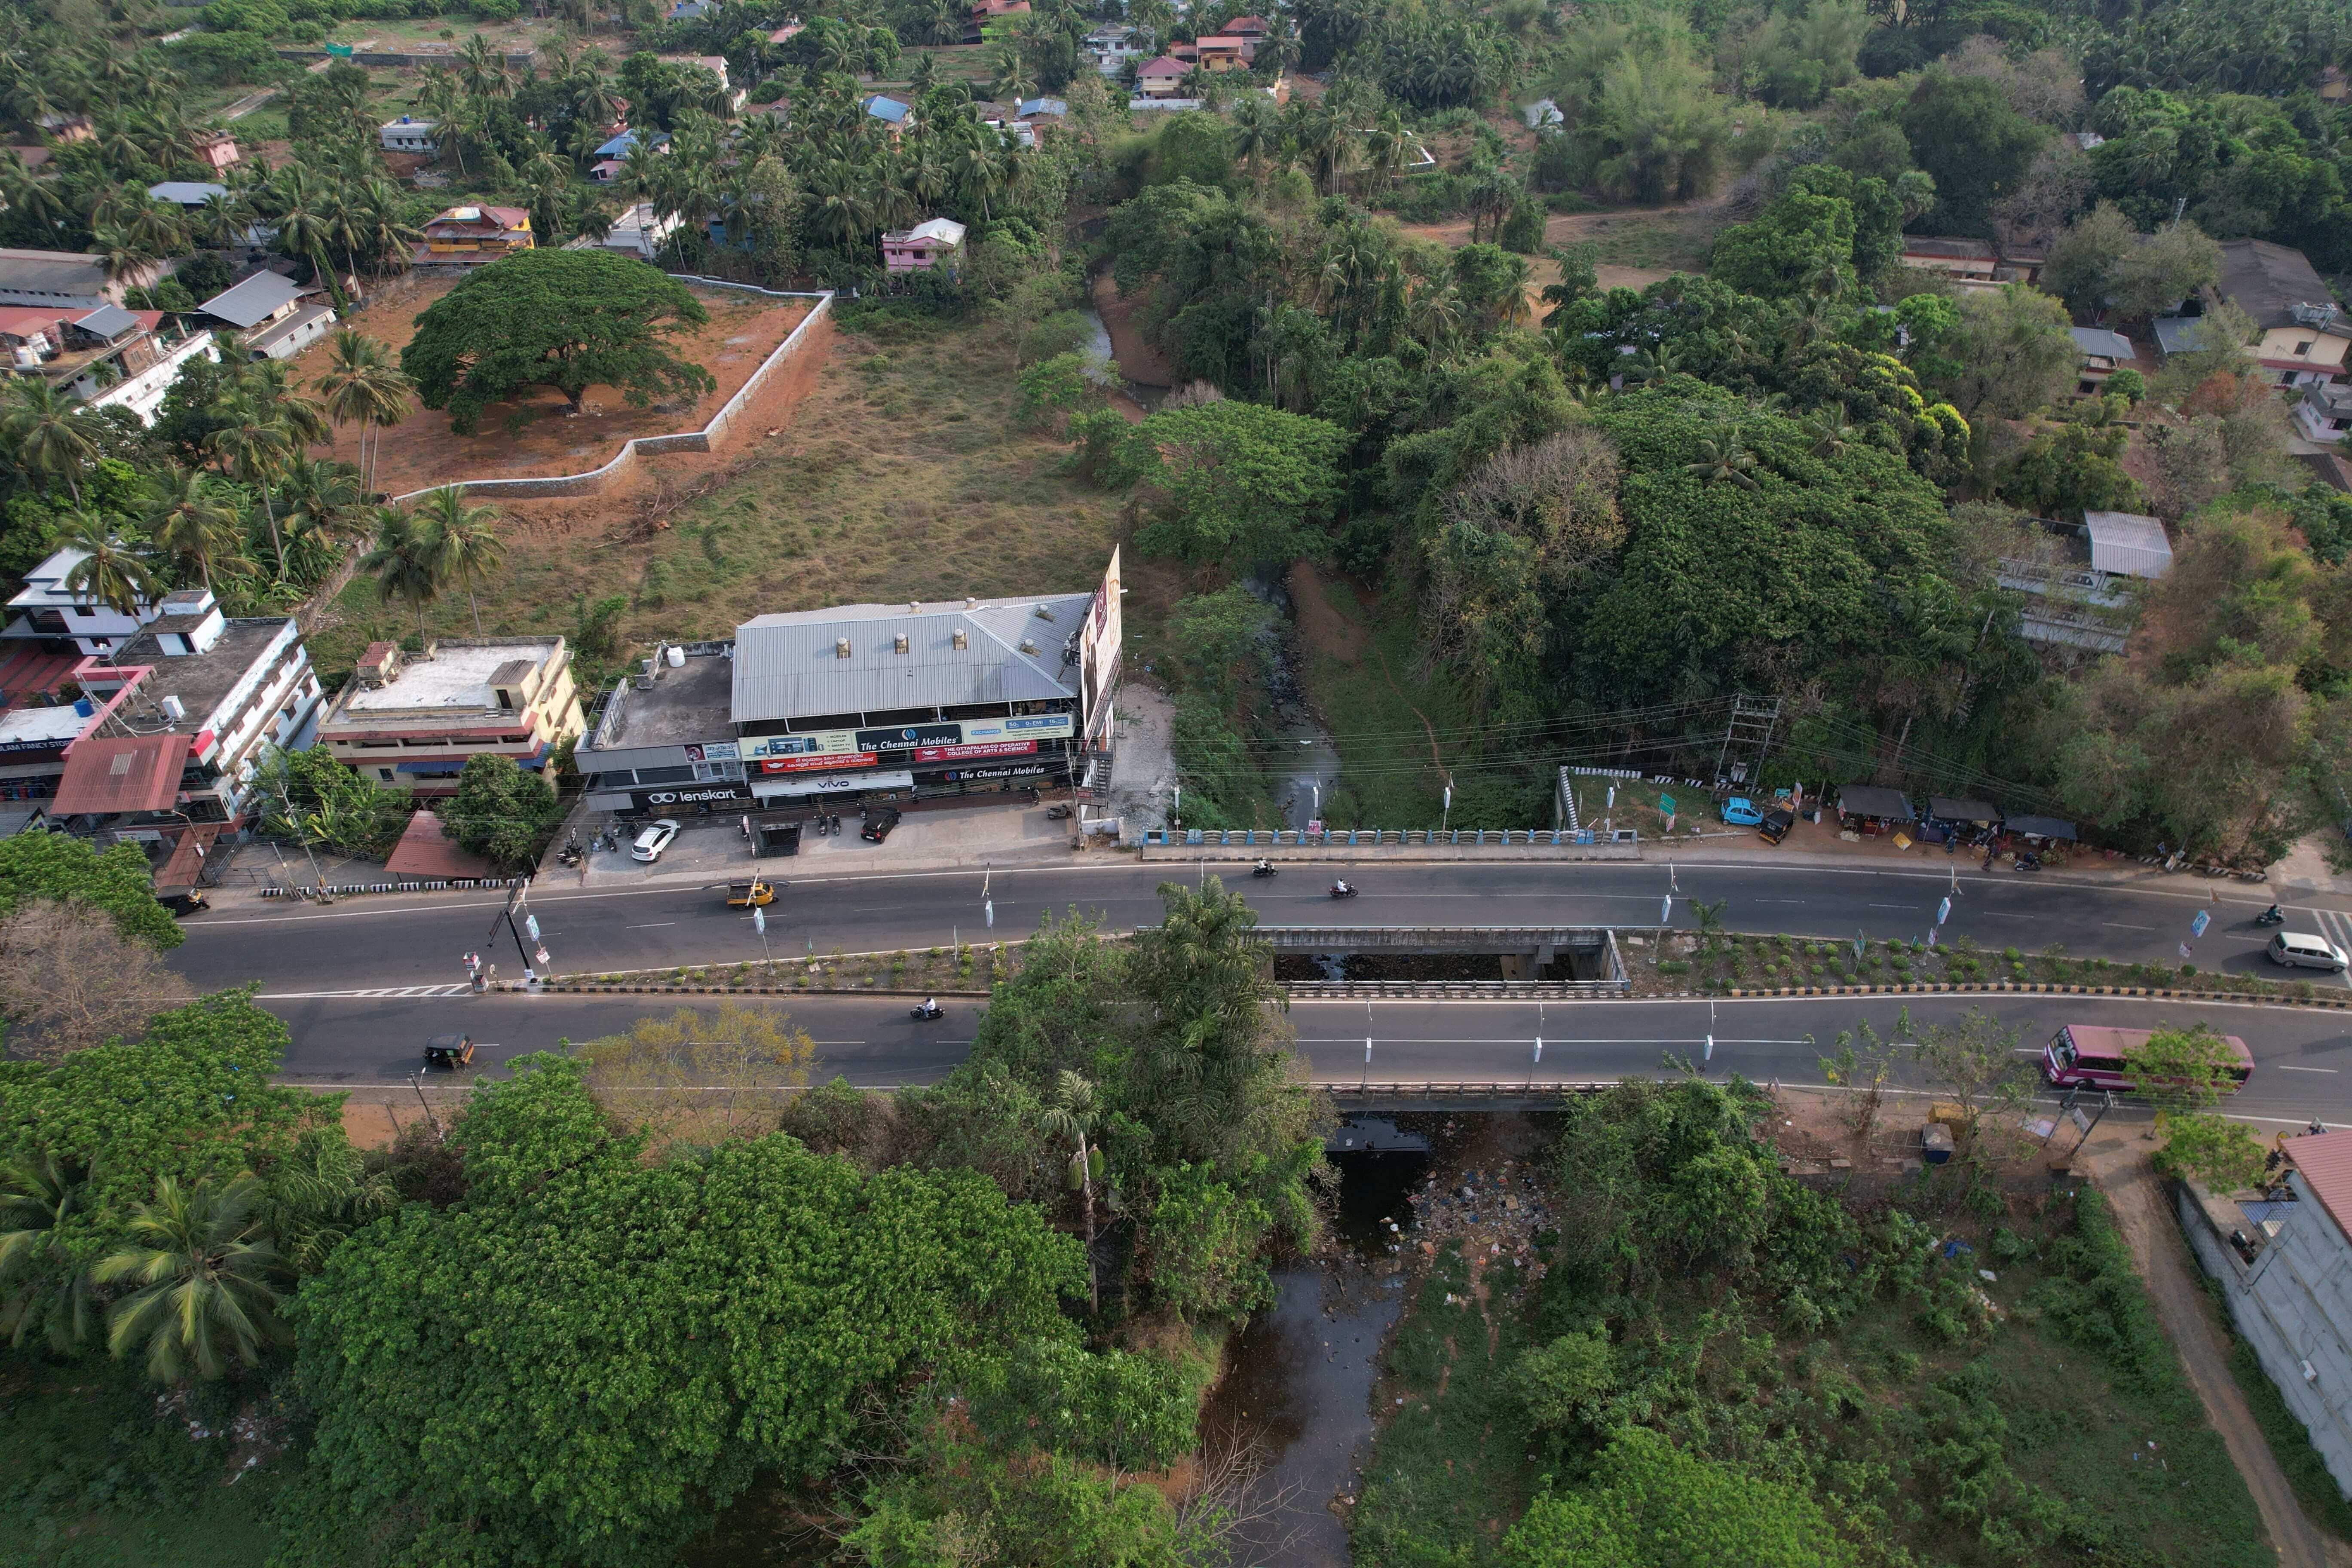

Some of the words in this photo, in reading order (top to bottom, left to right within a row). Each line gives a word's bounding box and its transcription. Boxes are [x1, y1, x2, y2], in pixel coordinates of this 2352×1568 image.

[861, 743, 877, 751] The
[880, 739, 919, 749] Chennai
[921, 736, 957, 746] Mobiles
[960, 771, 974, 779] The
[977, 769, 1011, 778] Chennai
[1013, 766, 1044, 775] Mobiles
[679, 789, 736, 802] lenskart
